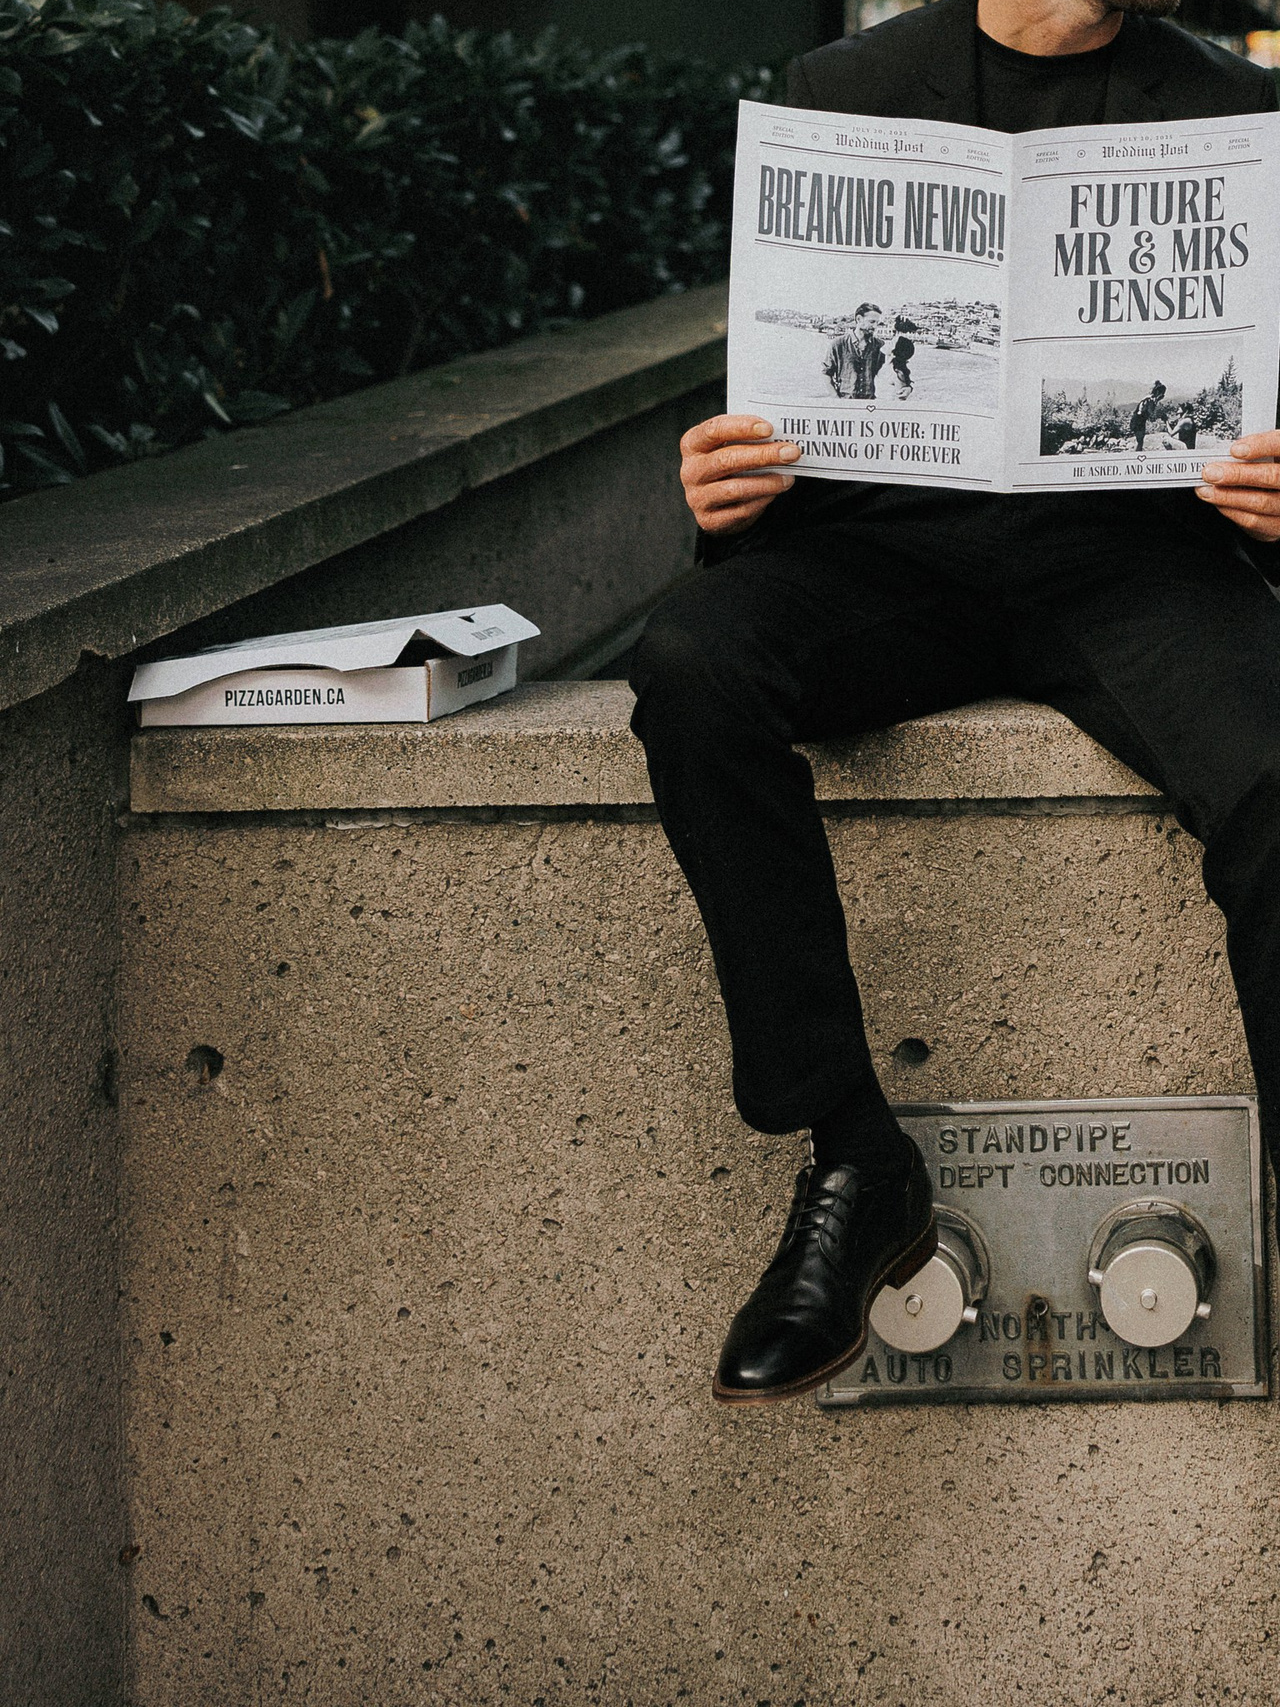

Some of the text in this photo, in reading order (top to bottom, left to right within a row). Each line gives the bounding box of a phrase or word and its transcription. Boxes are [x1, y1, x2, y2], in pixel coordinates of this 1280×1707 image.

[773, 125, 794, 133] SPECIAL
[835, 133, 924, 154] Wedding Post
[1102, 143, 1189, 159] Wedding Post
[1227, 143, 1250, 151] EDITION
[966, 155, 991, 163] EDITION
[758, 164, 1006, 262] BREAKING NEWS!!
[1069, 176, 1225, 229] FUTURE
[1054, 222, 1249, 277] MR & MRS
[1078, 274, 1225, 324] JENSEN
[780, 417, 961, 442] THE WAIT IS OVER: THE
[774, 438, 961, 465] GINNING OF FOREVER
[1073, 466, 1086, 478] HE
[1088, 464, 1122, 477] ASKED,
[1124, 463, 1143, 476] AND
[1146, 463, 1164, 475] SHE
[1166, 462, 1187, 474] SAID
[224, 688, 345, 707] PIZZAGARDEN.CA
[939, 1121, 1132, 1154] STANDPIPE
[939, 1159, 1209, 1189] DEPT CONNECTION
[979, 1310, 1097, 1342] NORTH
[859, 1346, 1223, 1385] AUTO SPRINKLER
